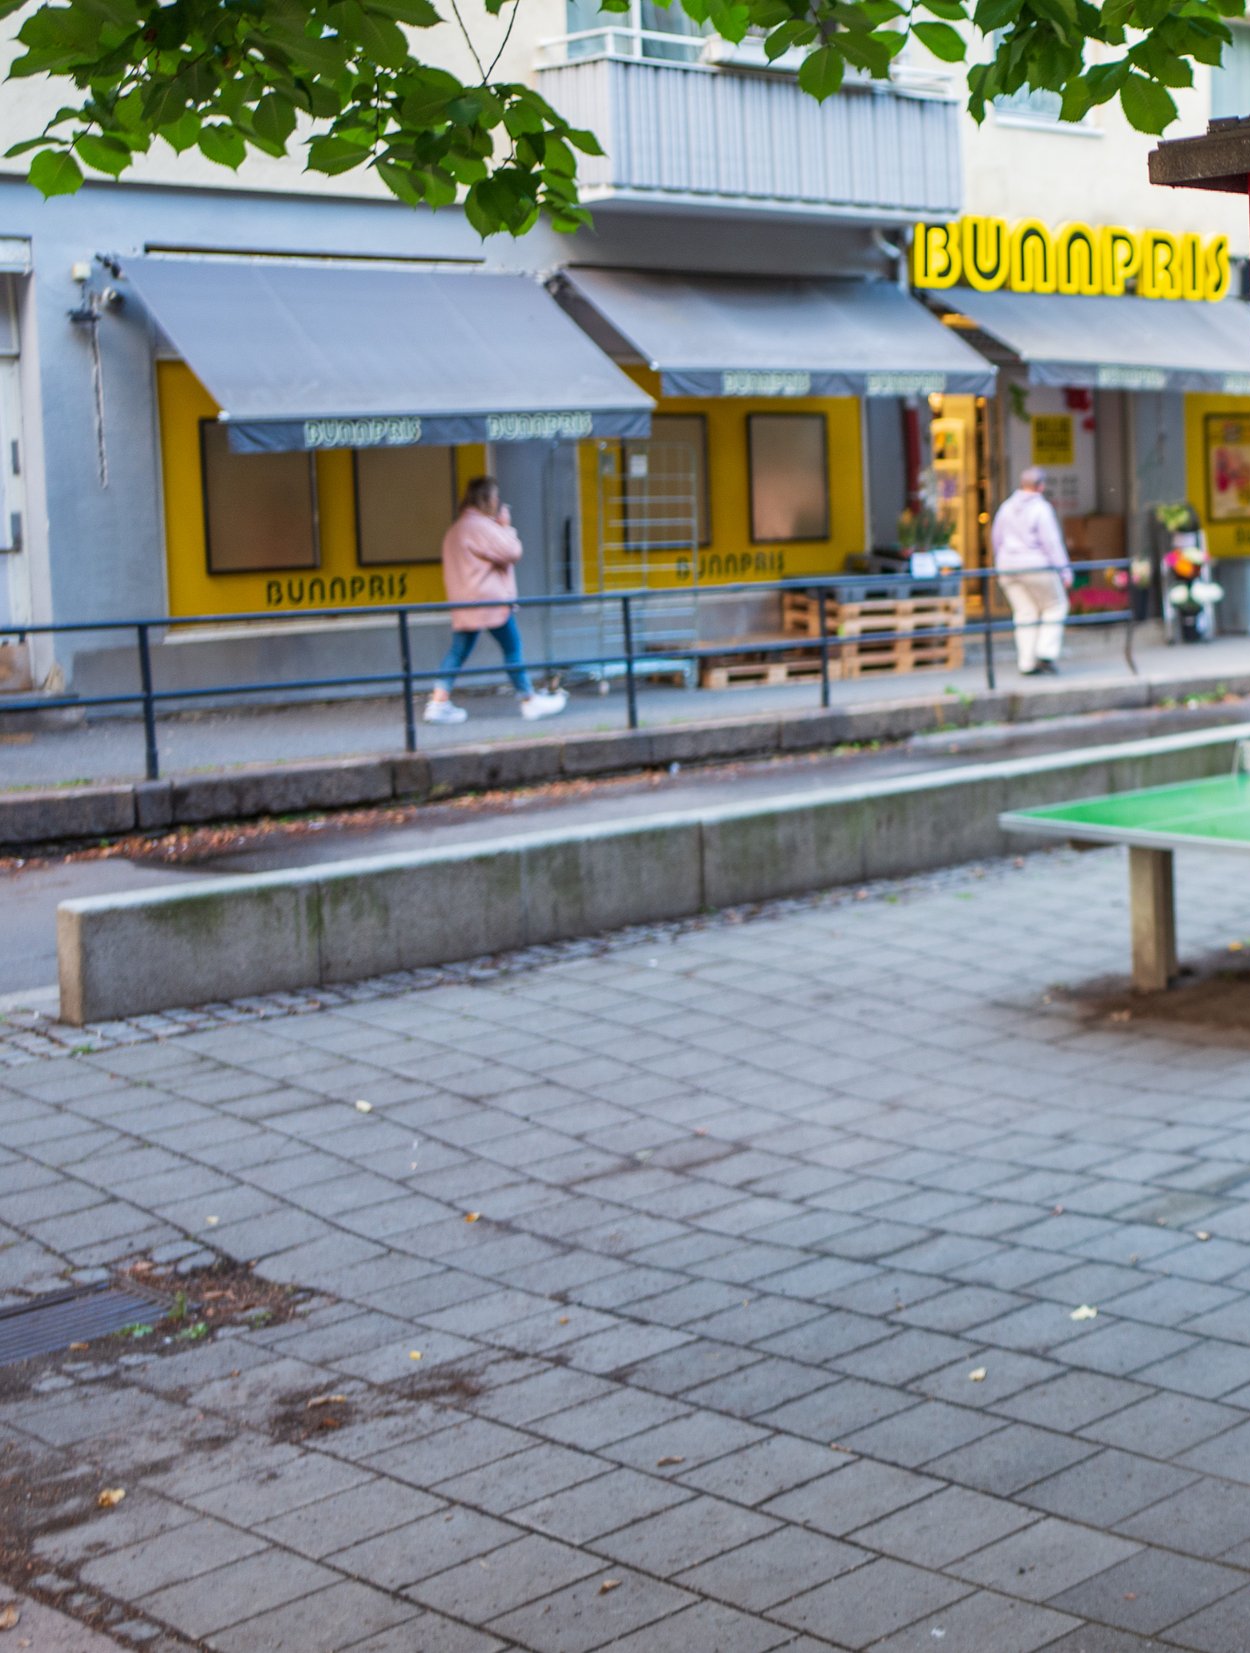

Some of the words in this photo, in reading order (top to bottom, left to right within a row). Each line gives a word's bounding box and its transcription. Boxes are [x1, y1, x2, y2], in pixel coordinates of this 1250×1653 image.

[915, 214, 1231, 302] BUNNPRIS
[304, 417, 422, 448] BUNNPRIS
[486, 410, 594, 441] BUNNPRIS
[266, 573, 408, 607] BUNNPRIS
